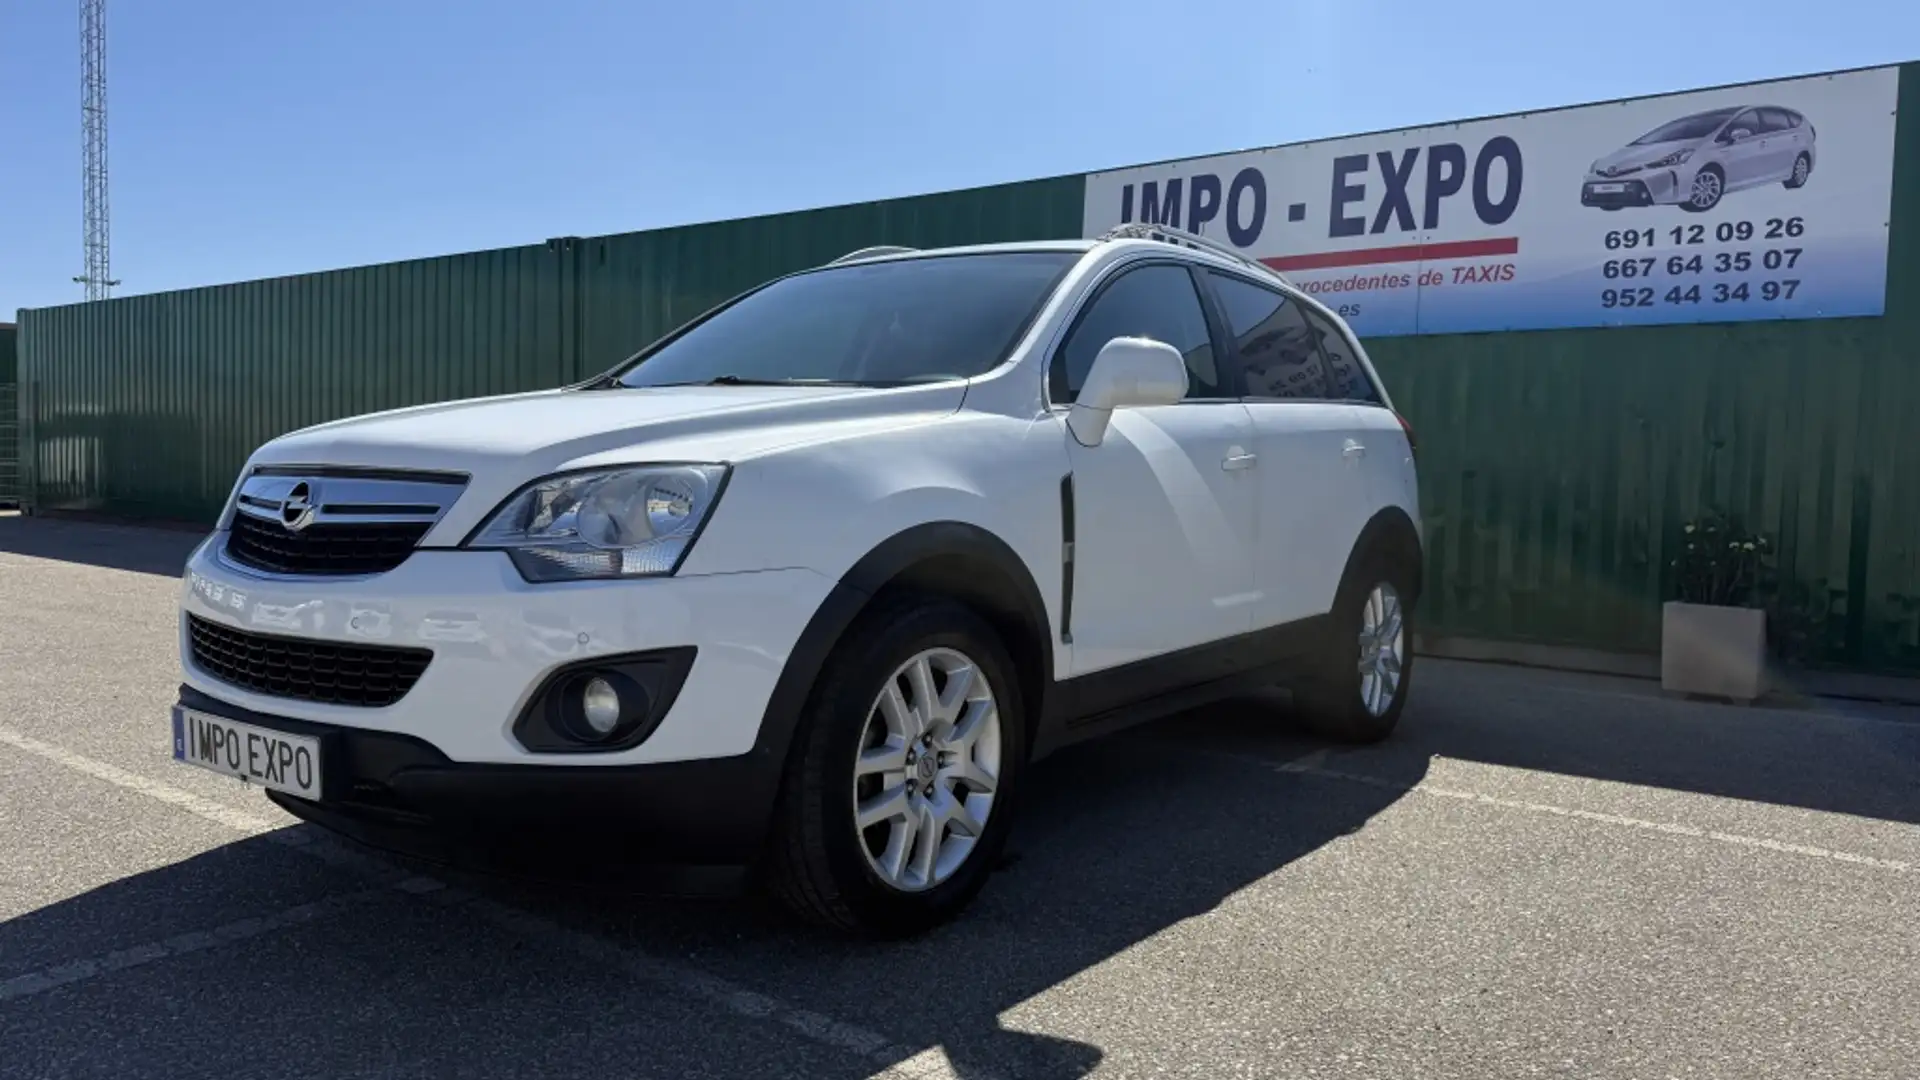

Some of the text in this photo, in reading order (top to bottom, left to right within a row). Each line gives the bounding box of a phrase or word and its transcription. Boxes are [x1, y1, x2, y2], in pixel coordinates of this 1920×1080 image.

[1121, 167, 1267, 248] IMPO
[1328, 135, 1523, 238] EXPO
[1605, 216, 1804, 250] 691 12 09 26
[1418, 268, 1443, 286] de
[1451, 263, 1516, 285] TAXIS
[1603, 248, 1803, 279] 667 64 35 07
[1601, 279, 1801, 309] 952 44 34 97
[189, 716, 312, 789] IMPO EXPO
